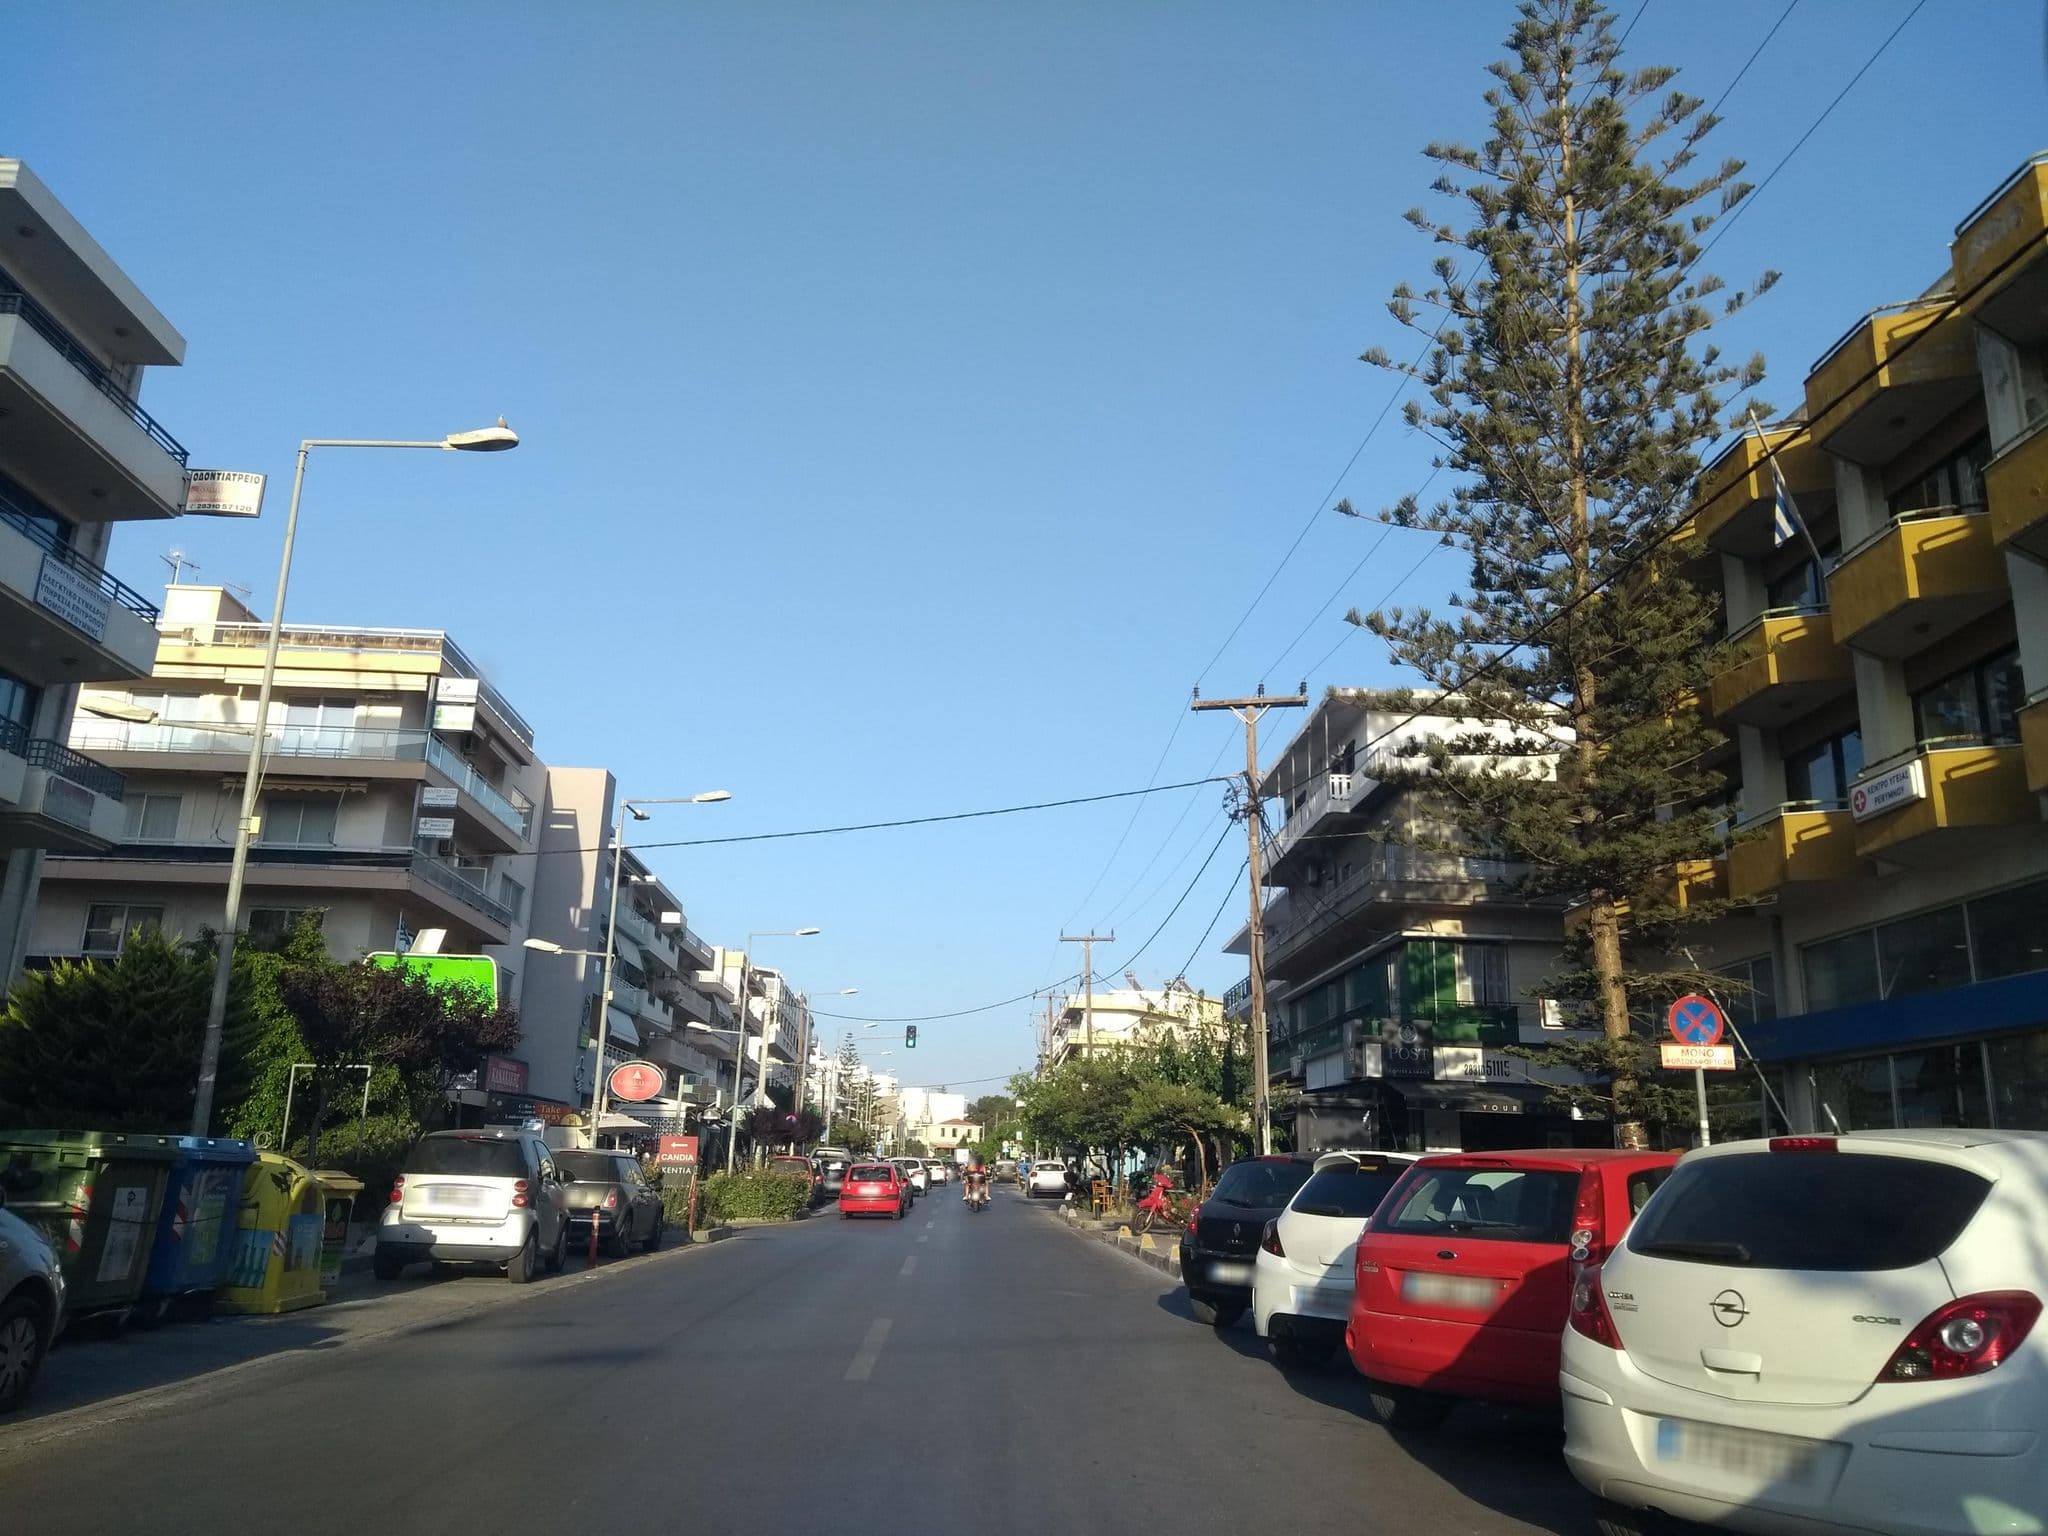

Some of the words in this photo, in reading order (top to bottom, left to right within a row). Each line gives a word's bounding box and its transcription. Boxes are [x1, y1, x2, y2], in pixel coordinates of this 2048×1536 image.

[193, 472, 261, 484] ΟΔΟΝΤΙΑΤΡΕΙΟ
[43, 573, 77, 600] ΕΛΕΓΚΤΙΚΟ
[40, 581, 71, 609] ΥΠΗΡΕΣΙΑ
[42, 595, 66, 615] ΝΟΜΟΥ
[1867, 778, 1889, 794] ΚΕΝΤΡΟ
[1889, 769, 1909, 784] ΥΓΕΙΑΣ
[1874, 785, 1905, 806] ΡΕΘΥΜΝΟΥ
[1389, 1047, 1430, 1061] POST
[1681, 1048, 1715, 1058] ΜΟΝΟ
[541, 1104, 561, 1114] Take
[1482, 1103, 1518, 1112] YOUR
[661, 1153, 694, 1161] CANDIA
[661, 1166, 692, 1174] KENTIA
